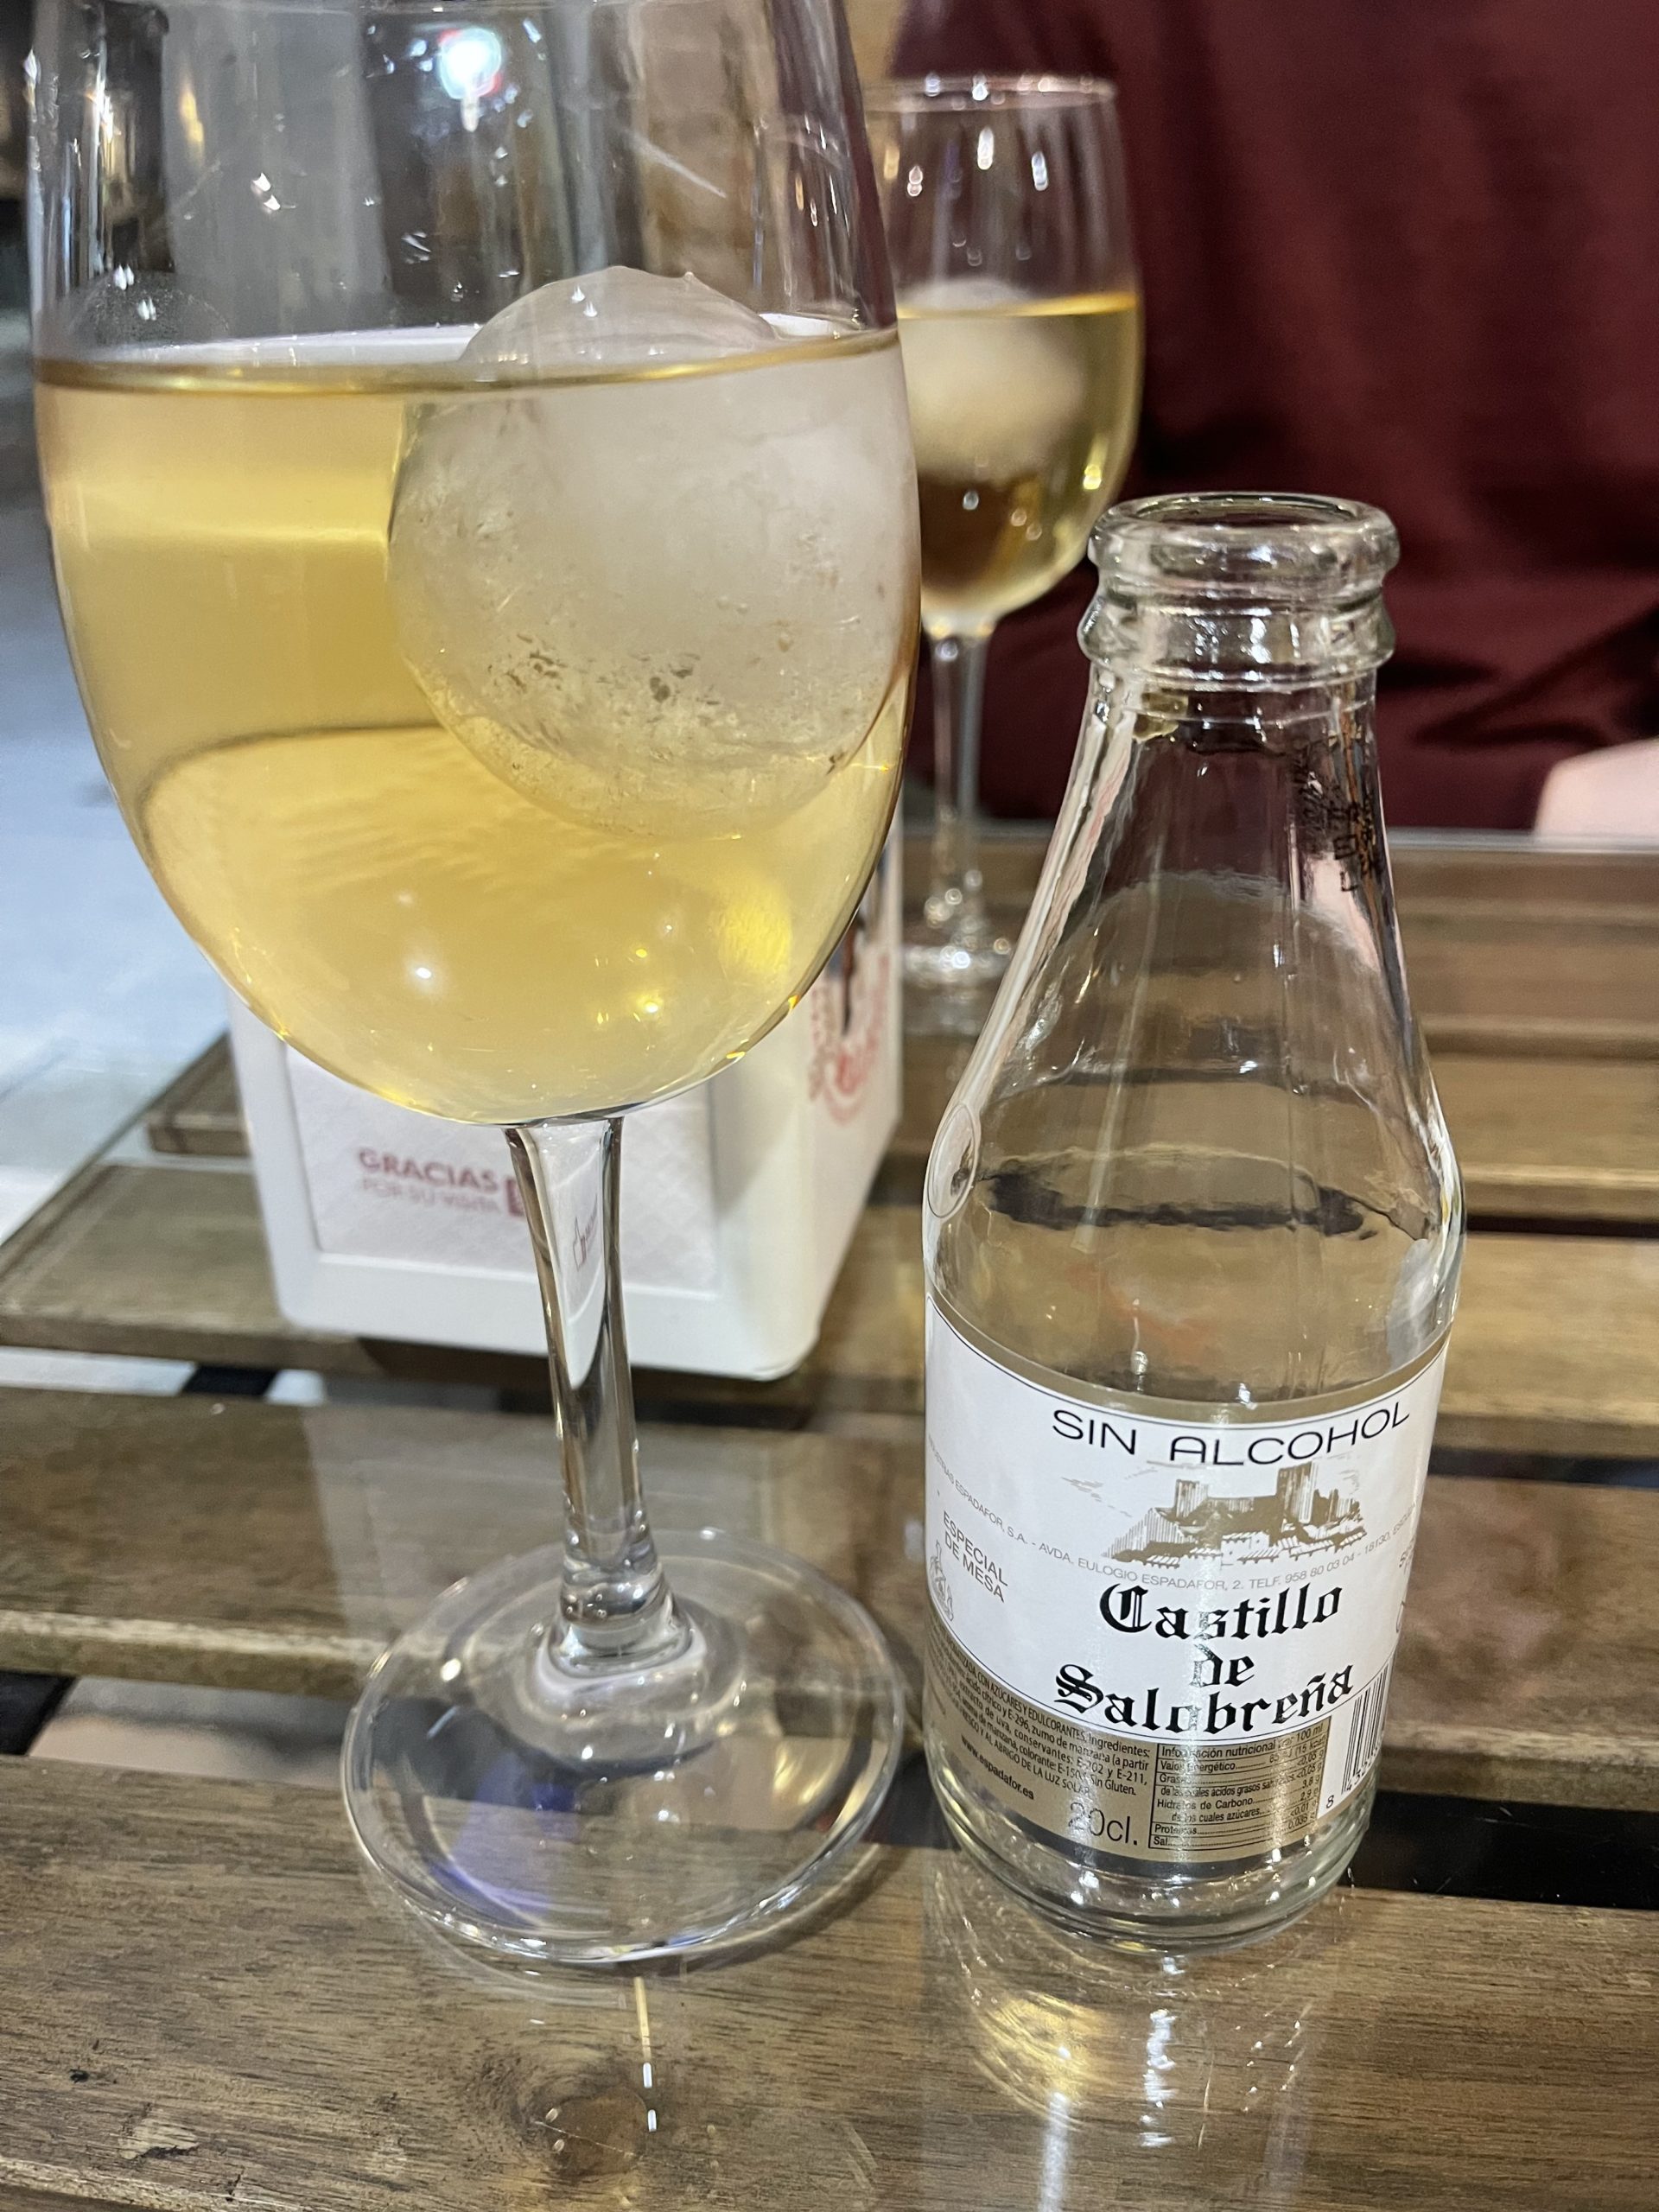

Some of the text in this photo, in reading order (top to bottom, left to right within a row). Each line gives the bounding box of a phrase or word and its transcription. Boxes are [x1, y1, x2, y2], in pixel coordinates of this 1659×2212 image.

[359, 1147, 499, 1194] GRACIAS
[1052, 1402, 1409, 1465] SIN ALCOHOL
[944, 1510, 1008, 1586] ESPECIAL
[955, 1479, 1006, 1533] ESPADAFOR,
[1007, 1526, 1028, 1545] S.A.
[1039, 1542, 1075, 1565] AVDA.
[1078, 1558, 1138, 1582] EULOGIO
[1141, 1573, 1228, 1592] ESPADAFOR,
[1232, 1580, 1244, 1591] 2.
[1249, 1577, 1281, 1589] TELF.
[1285, 1570, 1307, 1584] 958
[1310, 1565, 1324, 1578] 80
[1326, 1560, 1340, 1573] 03
[1343, 1554, 1355, 1567] 04
[945, 1531, 1004, 1603] DE MESA
[1099, 1582, 1344, 1641] Castillo
[1190, 1643, 1255, 1688] de
[977, 1670, 990, 1688] CON
[991, 1680, 1022, 1713] AZÚCARES
[1053, 1663, 1354, 1735] Salobreña
[985, 1706, 995, 1719] de
[1014, 1728, 1073, 1765] conservantes:
[1107, 1768, 1114, 1780] y
[1116, 1770, 1147, 1786] E-211,
[985, 1732, 994, 1745] AL
[994, 1738, 1020, 1764] ABRIGO
[1021, 1758, 1032, 1772] DE
[1033, 1765, 1044, 1779] LA
[1044, 1770, 1060, 1786] LUZ
[1032, 1726, 1055, 1745] zumo
[1056, 1737, 1068, 1750] de
[1070, 1744, 1110, 1764] manzana
[1112, 1753, 1121, 1767] (a
[1122, 1758, 1151, 1772] partir
[1161, 1745, 1223, 1758] Infoación
[1226, 1740, 1276, 1758] nutricional
[1297, 1728, 1311, 1741] 100
[961, 1733, 1034, 1800] www.espadafor.es
[1090, 1774, 1103, 1788] Sin
[1160, 1787, 1170, 1796] de
[1236, 1783, 1260, 1797] grasos
[1200, 1800, 1211, 1810] de
[1215, 1797, 1253, 1810] Carbono
[1325, 1795, 1335, 1809] 8
[1199, 1809, 1224, 1821] cuales
[1154, 1835, 1168, 1846] Sal
